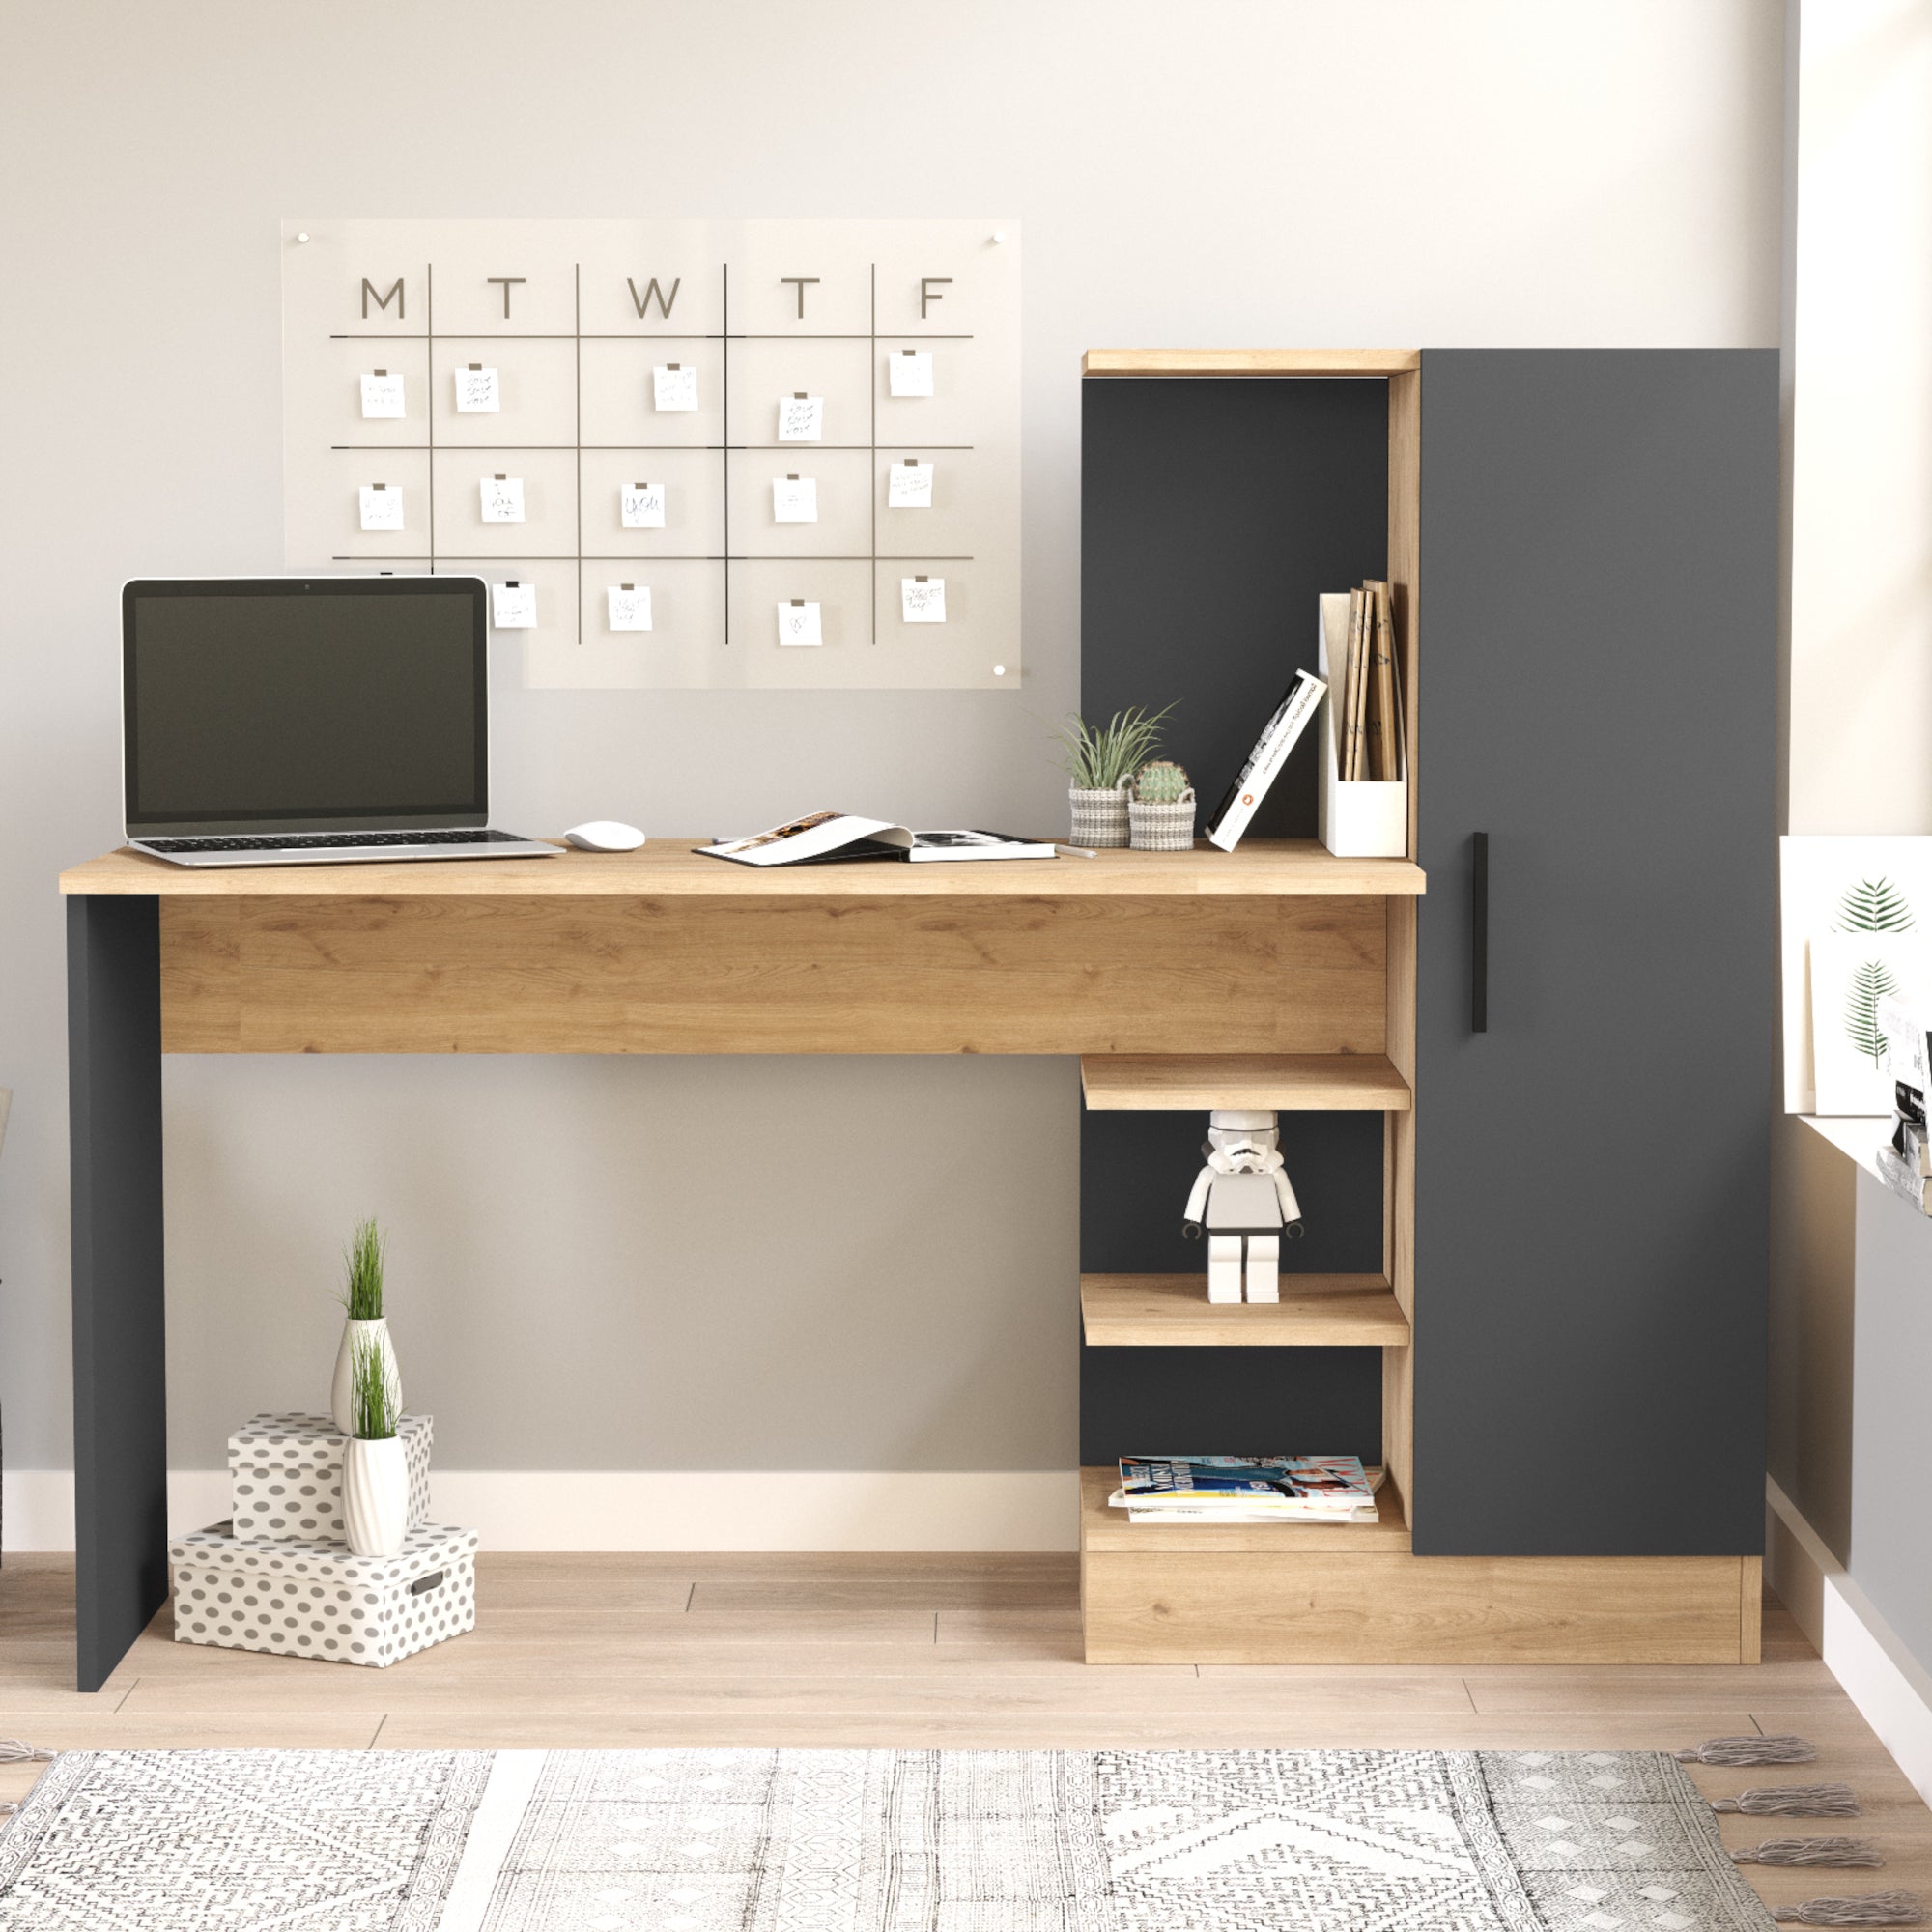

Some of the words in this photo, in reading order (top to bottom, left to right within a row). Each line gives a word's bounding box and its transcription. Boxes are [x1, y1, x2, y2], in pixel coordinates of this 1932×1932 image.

[361, 278, 404, 319] M
[487, 278, 526, 319] T
[627, 278, 681, 319] W
[781, 278, 820, 319] T
[921, 278, 953, 319] F
